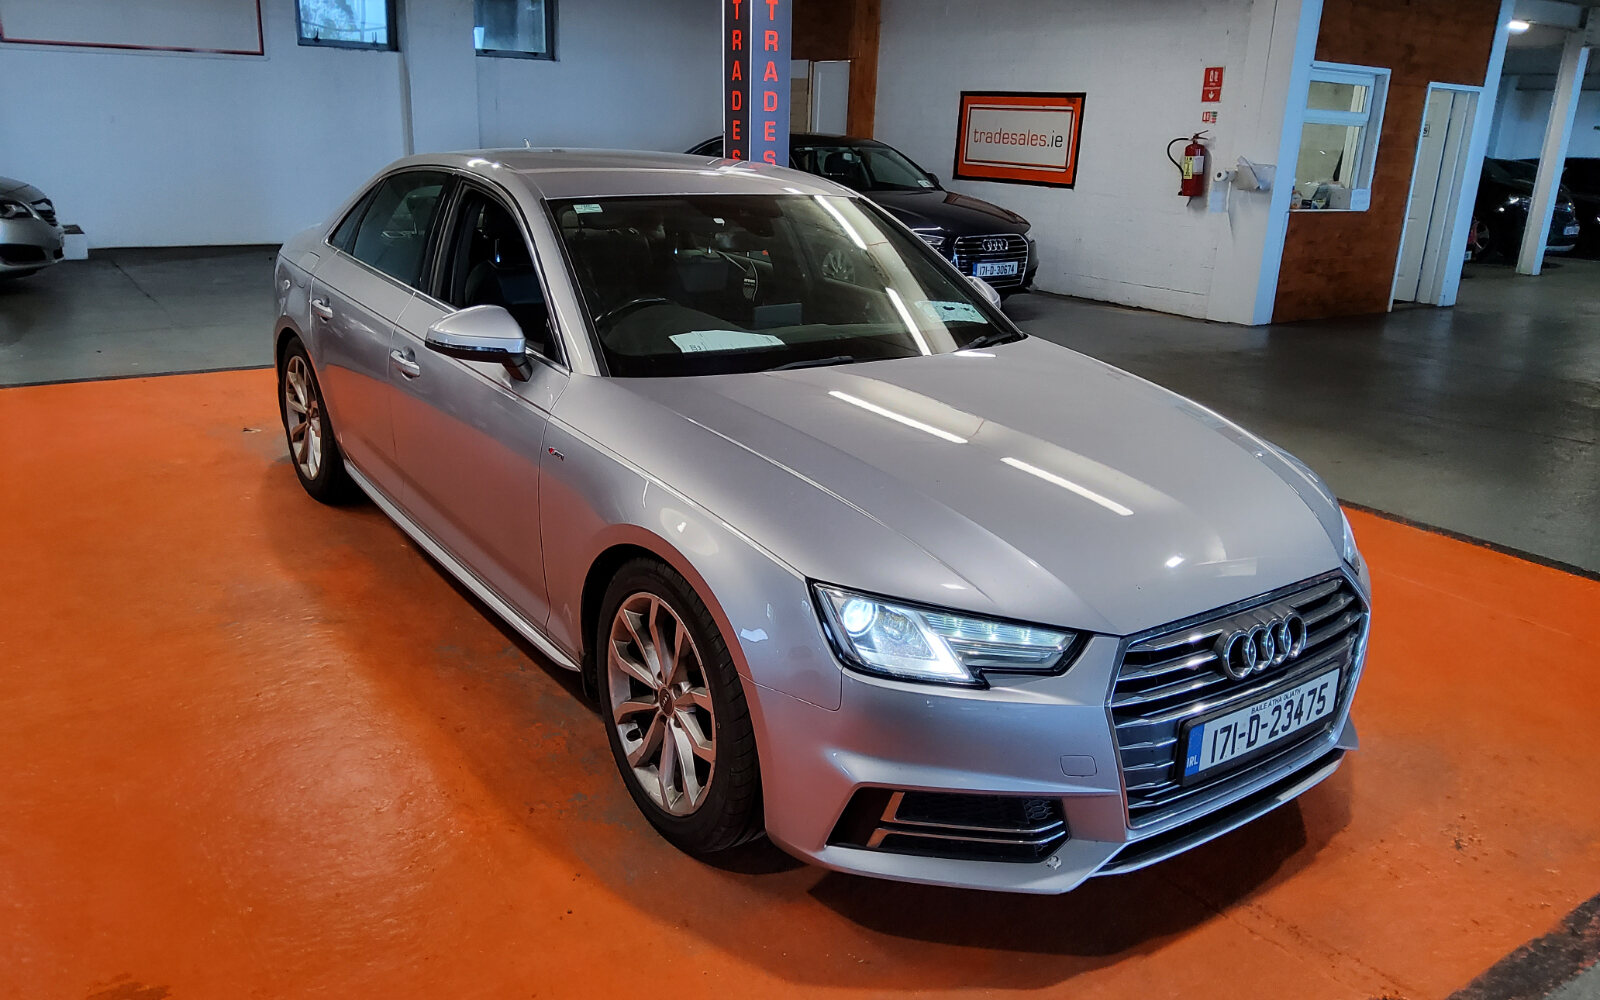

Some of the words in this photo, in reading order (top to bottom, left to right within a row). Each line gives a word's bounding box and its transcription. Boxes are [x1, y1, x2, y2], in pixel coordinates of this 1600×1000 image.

[763, 0, 779, 165] TRADES
[973, 127, 1063, 148] tradesales.ie
[980, 264, 1015, 276] 171-D-30674
[1251, 702, 1268, 714] BAILE
[1210, 682, 1329, 763] 171-D-23475
[1186, 754, 1198, 769] IRL
